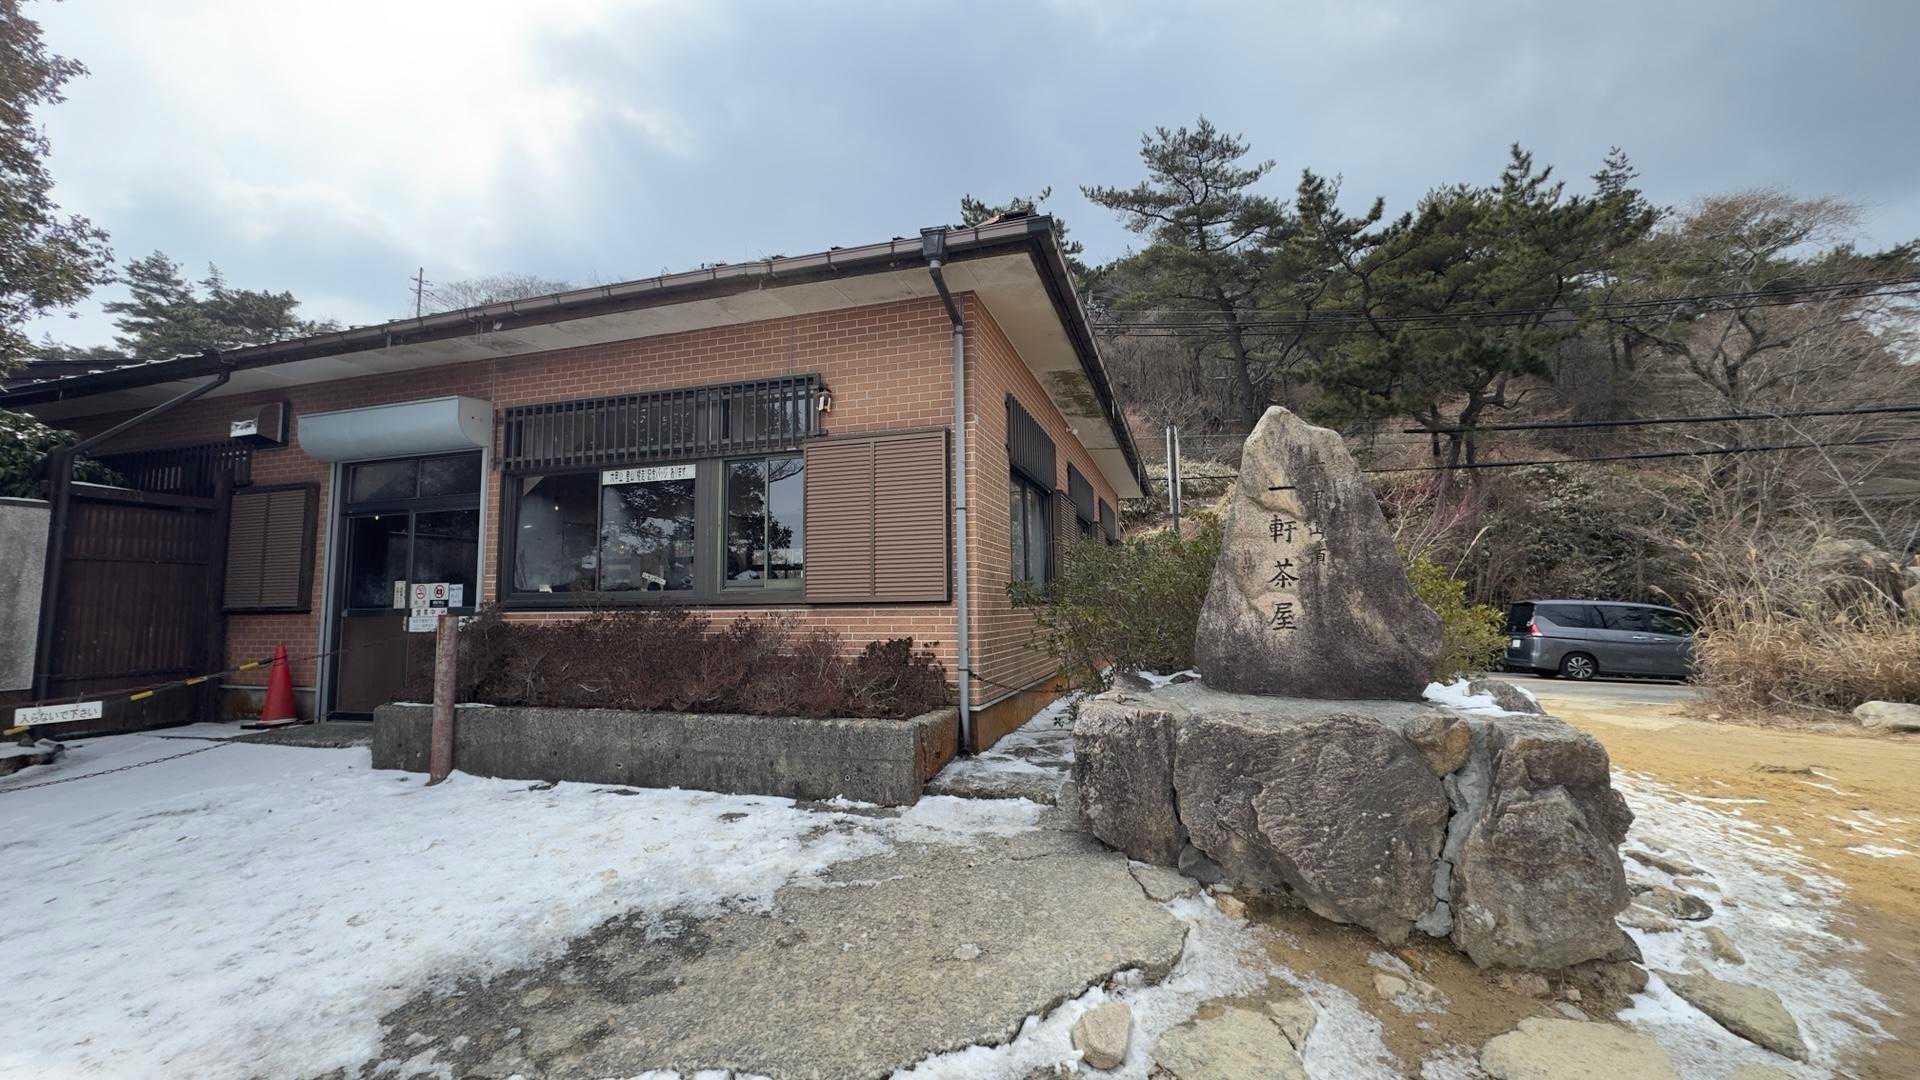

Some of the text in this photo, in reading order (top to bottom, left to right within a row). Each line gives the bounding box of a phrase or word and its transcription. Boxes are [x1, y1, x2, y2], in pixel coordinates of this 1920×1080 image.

[1268, 485, 1299, 631] 一軒茶屋
[19, 708, 98, 724] 入らないで下さい
